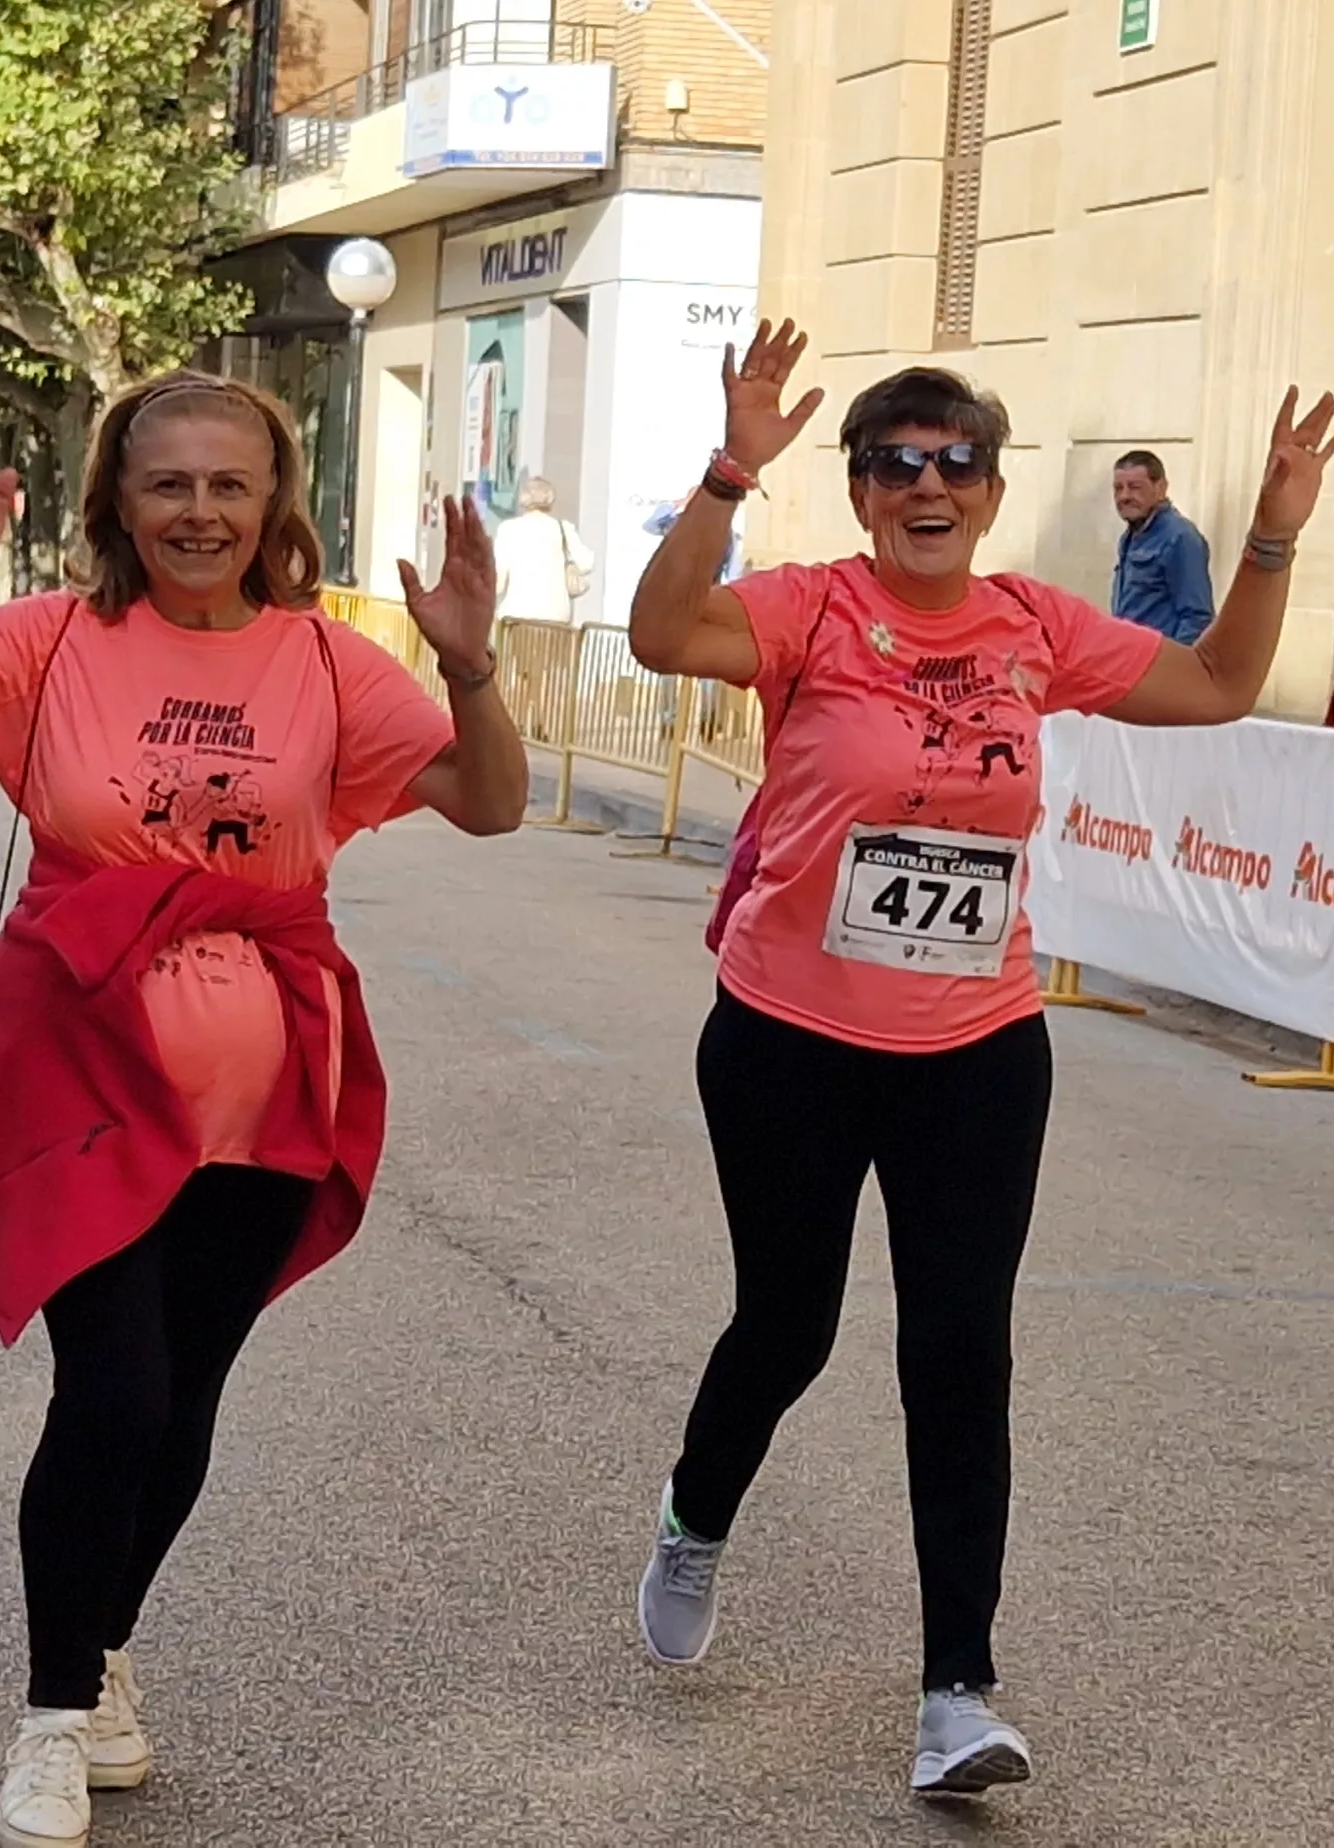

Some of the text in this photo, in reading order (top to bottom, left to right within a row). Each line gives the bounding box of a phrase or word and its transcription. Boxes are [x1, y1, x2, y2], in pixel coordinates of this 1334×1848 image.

[479, 226, 568, 287] VITALDENT
[686, 302, 745, 327] SMY
[160, 696, 247, 724] CORRAMOS
[136, 720, 255, 751] POR LA CIENCIA
[1060, 793, 1153, 866] Alcampo
[864, 847, 1004, 879] CONTRA EL CÁNCER
[1171, 815, 1272, 895] Alcampo
[871, 875, 984, 936] 474
